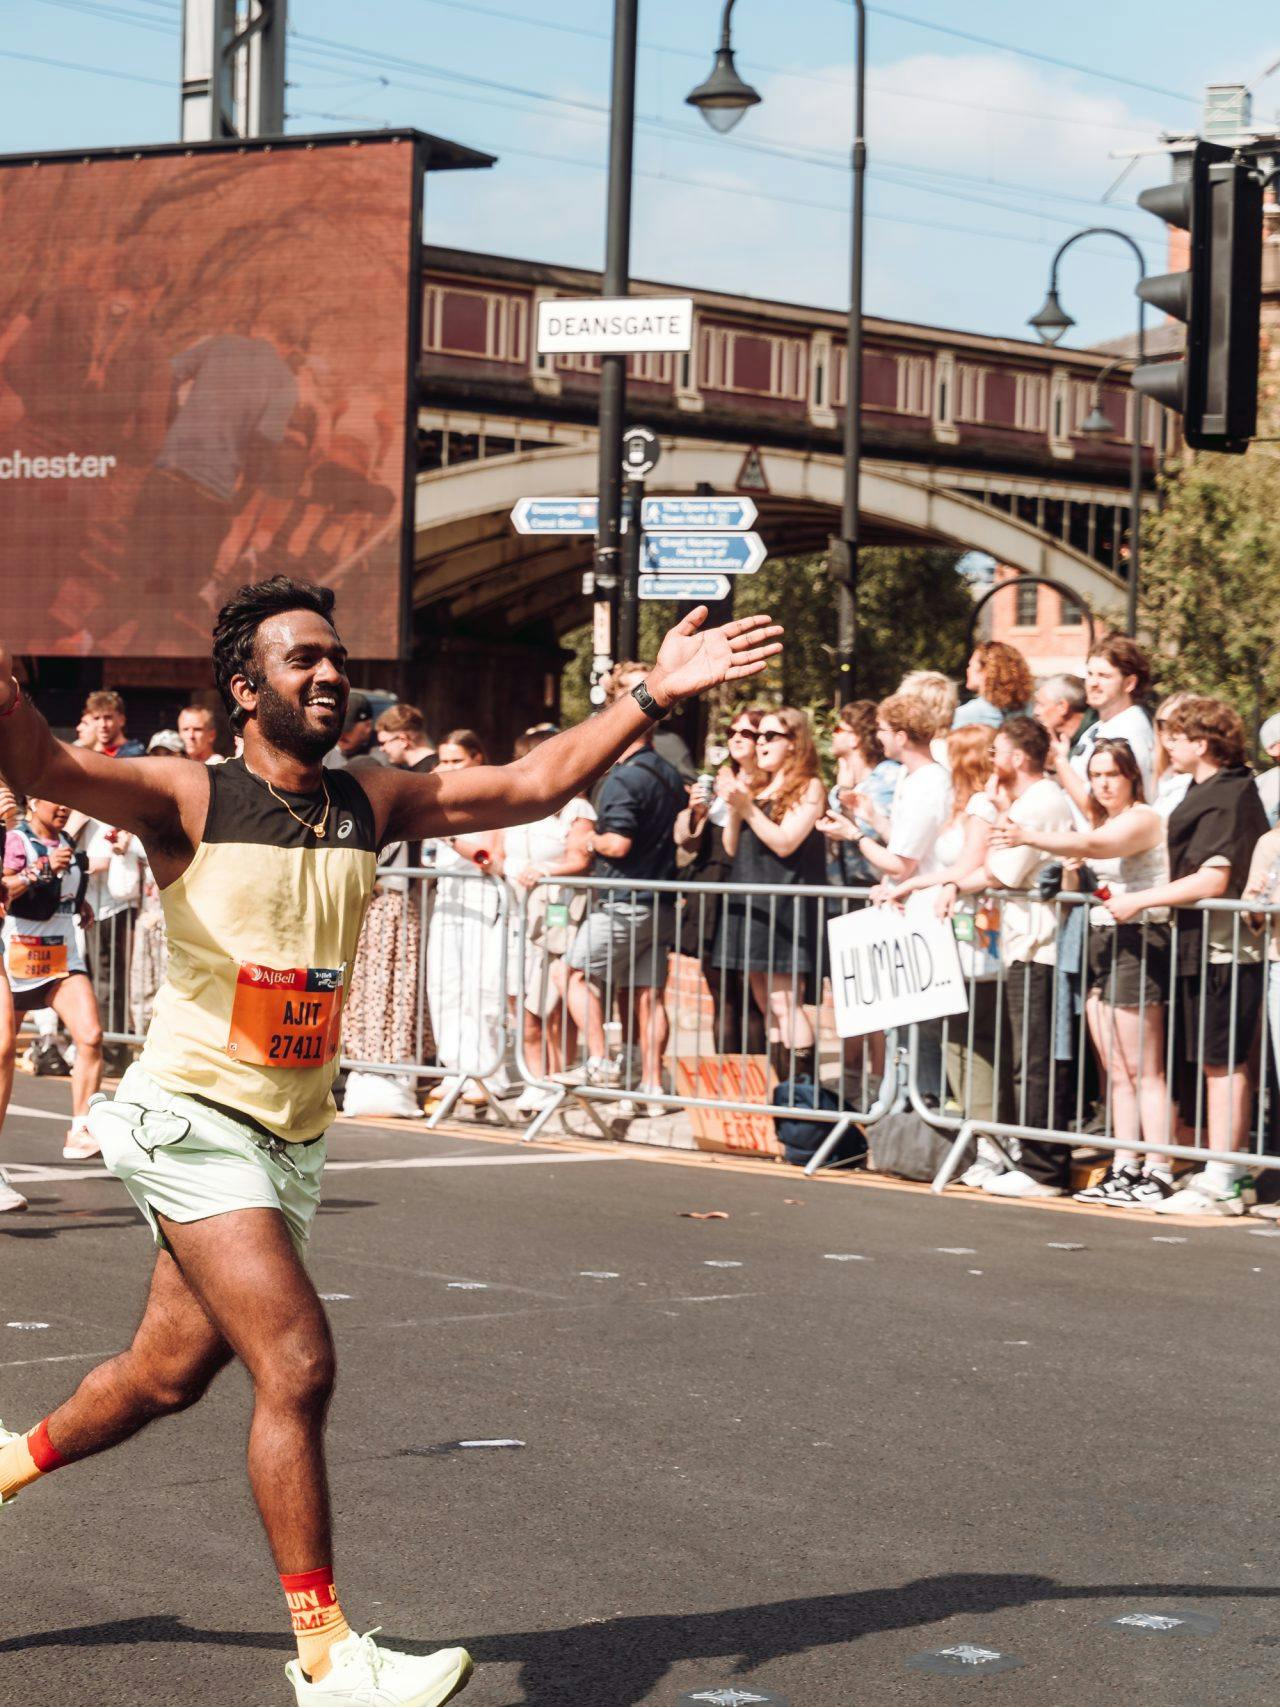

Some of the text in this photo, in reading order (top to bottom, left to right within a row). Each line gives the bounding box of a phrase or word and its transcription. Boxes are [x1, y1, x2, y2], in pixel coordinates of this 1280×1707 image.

[547, 315, 681, 336] DEANSGATE
[282, 1001, 322, 1026] AJIT
[268, 1034, 323, 1060] 27411
